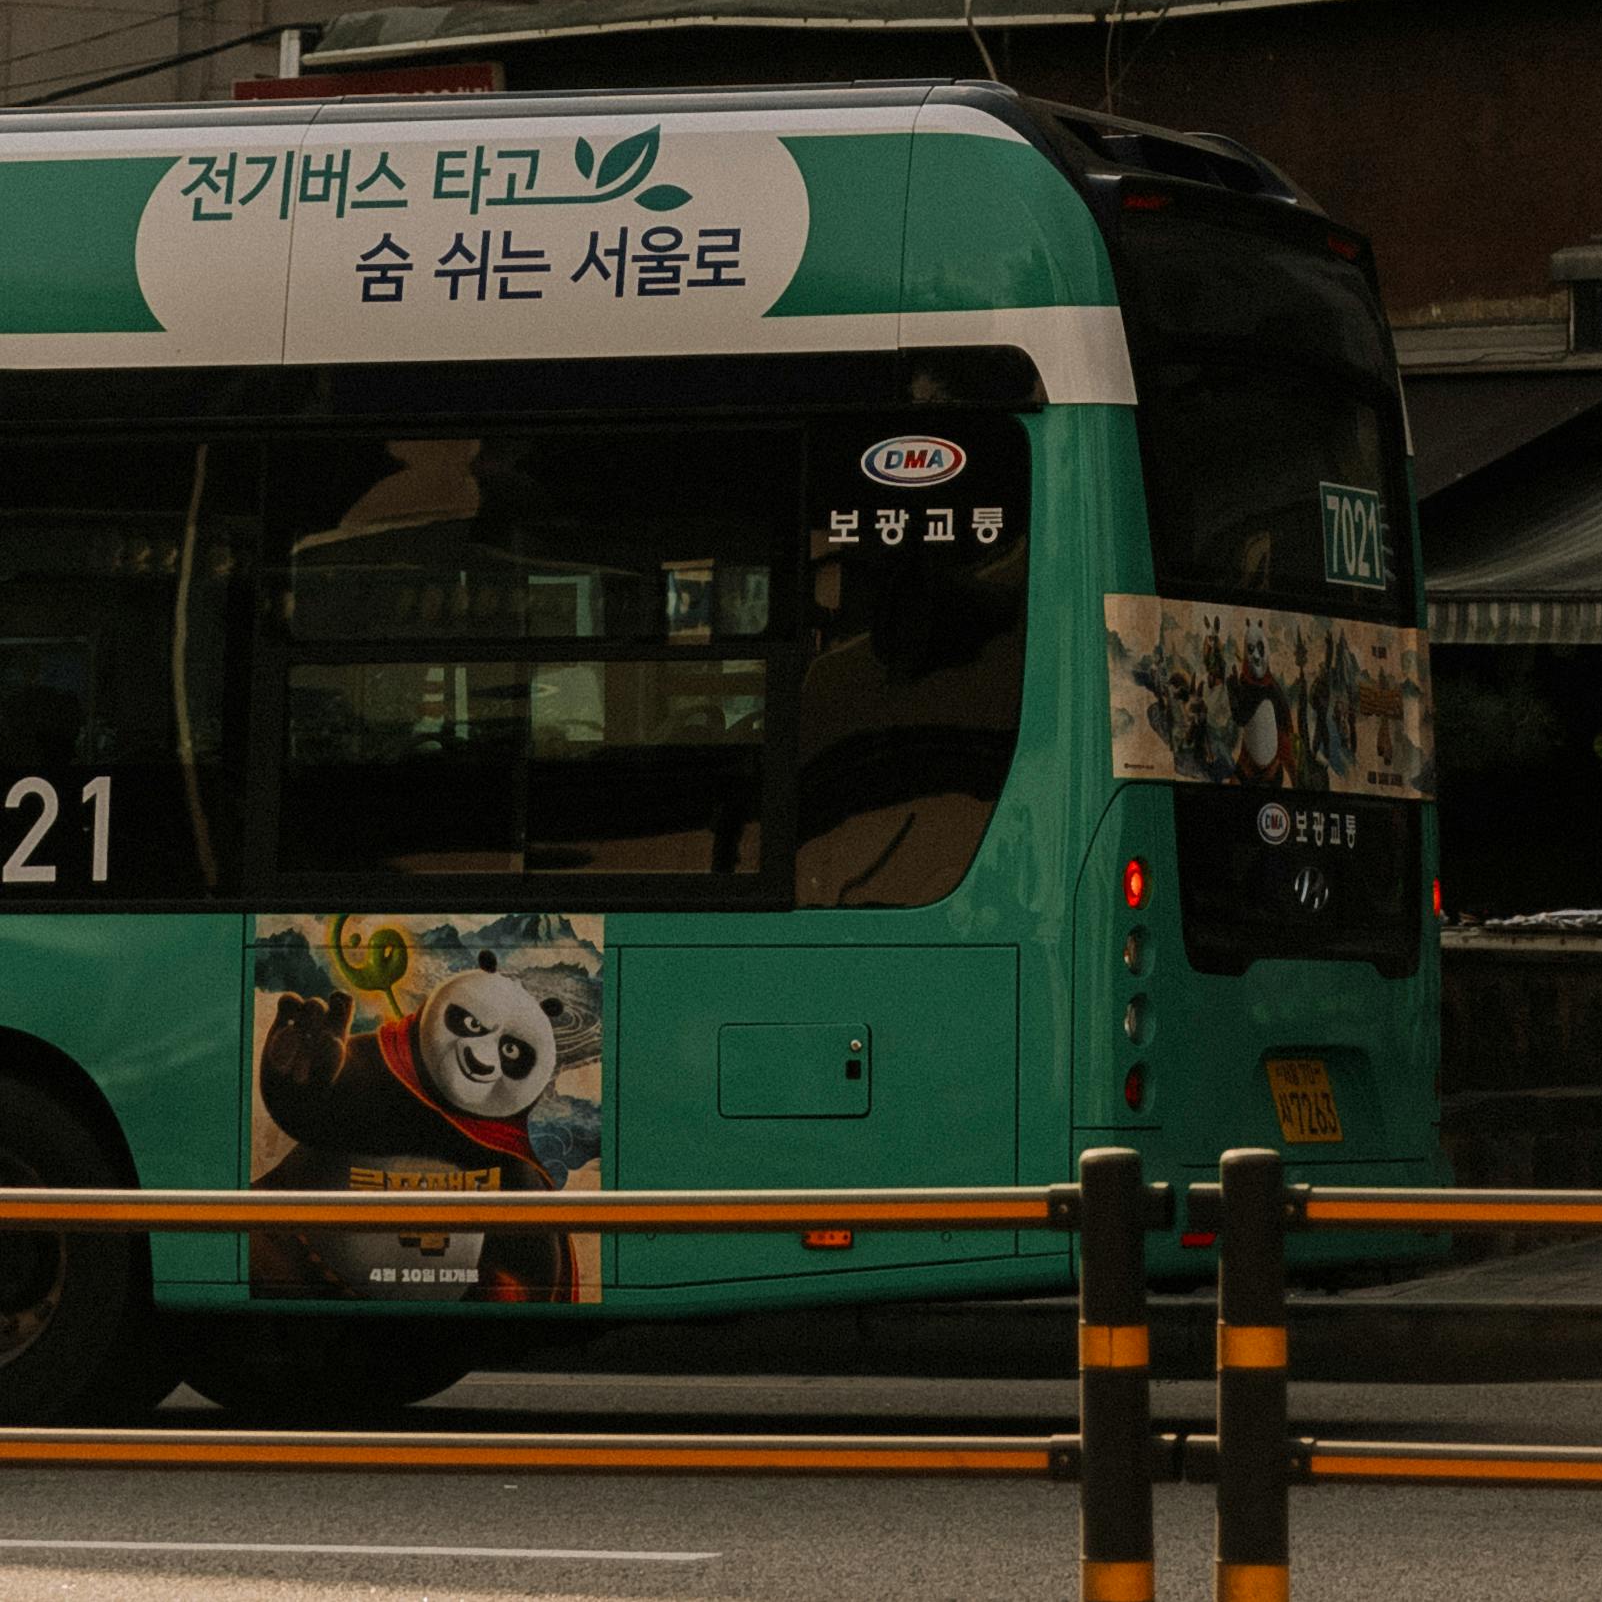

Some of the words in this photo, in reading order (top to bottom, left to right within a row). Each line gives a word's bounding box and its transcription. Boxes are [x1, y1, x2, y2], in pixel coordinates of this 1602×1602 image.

[180, 148, 408, 222] 전기버스
[431, 146, 545, 215] 타고
[355, 232, 414, 303] 숨
[434, 230, 552, 302] 쉬는
[570, 226, 746, 299] 서울로
[883, 447, 943, 473] DMA
[827, 507, 1004, 546] 보광교통
[1326, 494, 1381, 581] 7021
[2, 776, 112, 882] 21
[1295, 811, 1356, 849] 보광교통
[369, 1268, 396, 1282] 4월
[402, 1268, 435, 1283] 10일
